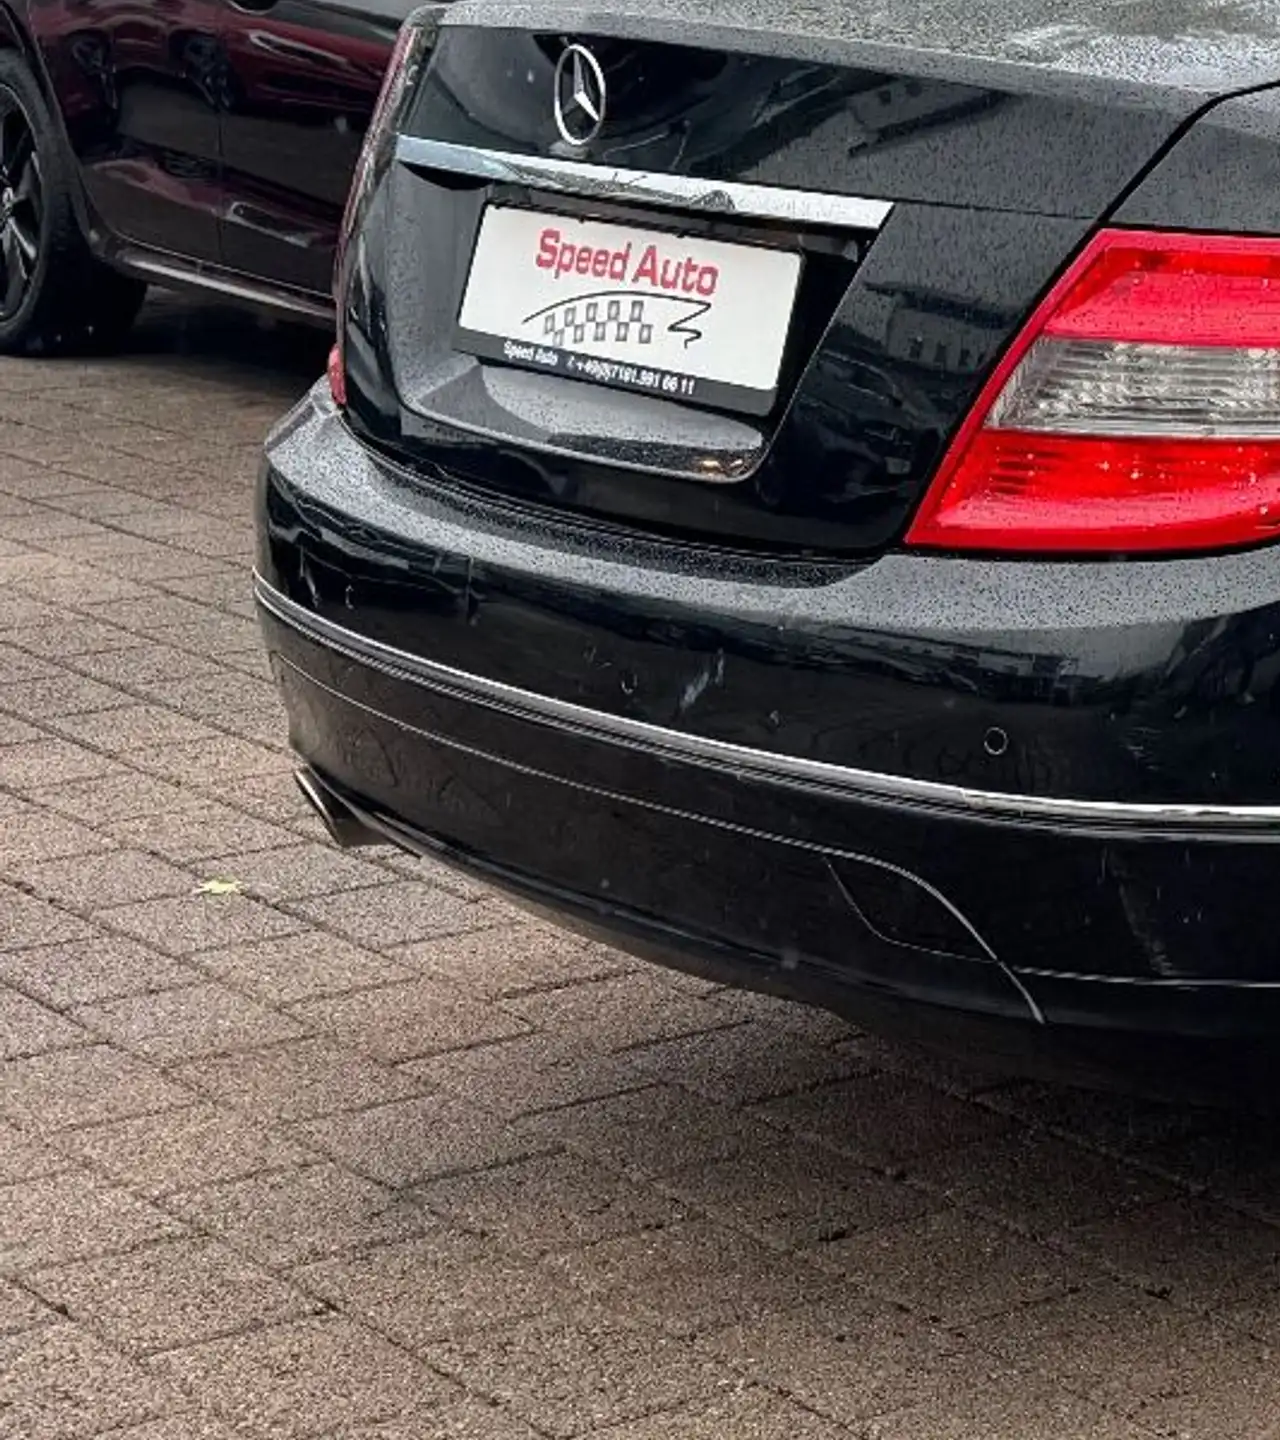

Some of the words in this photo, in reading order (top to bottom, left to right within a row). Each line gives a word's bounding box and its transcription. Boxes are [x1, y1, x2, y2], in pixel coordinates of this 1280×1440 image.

[535, 227, 632, 280] Speed
[632, 244, 719, 297] Auto
[503, 339, 534, 361] Speed
[535, 347, 559, 367] Auto
